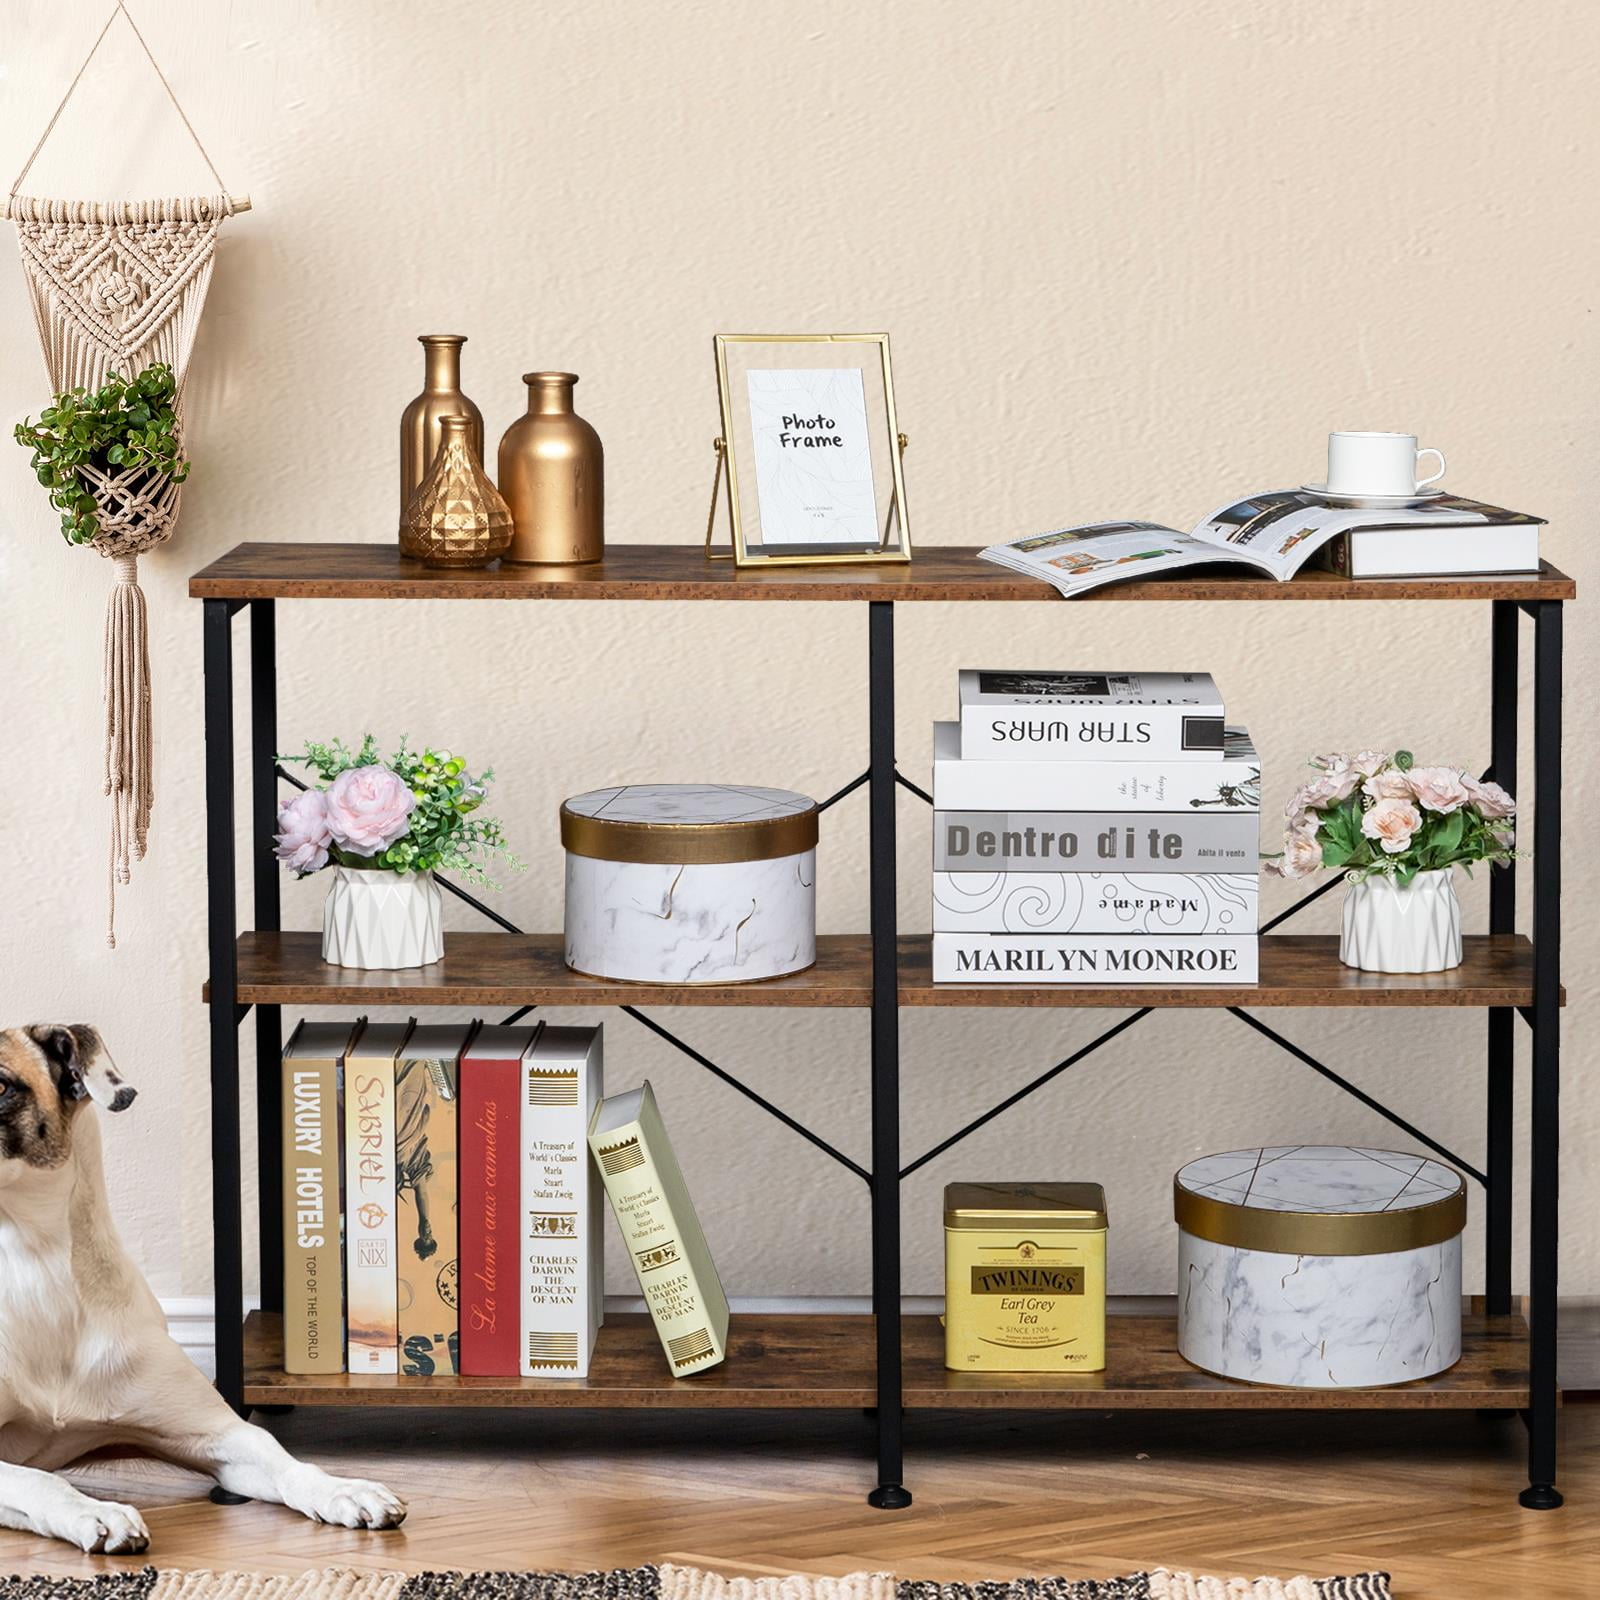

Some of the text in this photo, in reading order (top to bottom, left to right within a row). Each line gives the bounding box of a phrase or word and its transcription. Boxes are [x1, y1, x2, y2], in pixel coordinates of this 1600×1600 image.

[782, 413, 836, 430] Photo
[779, 432, 844, 448] Frame
[991, 720, 1151, 743] STAR WARS
[947, 825, 1183, 859] Dentro di te
[1098, 899, 1199, 912] Madame
[956, 949, 1238, 971] MARILYN MONROE
[532, 1141, 538, 1150] A
[567, 1141, 575, 1150] of
[293, 1072, 325, 1249] LUXURY HOTELS
[470, 1101, 497, 1334] La dame aux camelias
[360, 1248, 385, 1265] NIX
[529, 1255, 578, 1264] CHARLES
[531, 1265, 575, 1275] DARWIN
[543, 1276, 565, 1285] THE
[647, 1274, 688, 1293] CHARLES
[978, 1269, 1077, 1293] TWININGS
[530, 1285, 578, 1294] DESCENT
[652, 1282, 688, 1301] DARWIN
[306, 1255, 319, 1360] TOP OF THE WORLD
[532, 1295, 574, 1304] OF MAN
[655, 1295, 696, 1316] DESCENT
[664, 1294, 682, 1305] THE
[1000, 1298, 1056, 1313] Earl Grey
[661, 1304, 695, 1321] OF MAN
[1018, 1312, 1038, 1325] Tea
[1006, 1326, 1050, 1335] SINCE 1706
